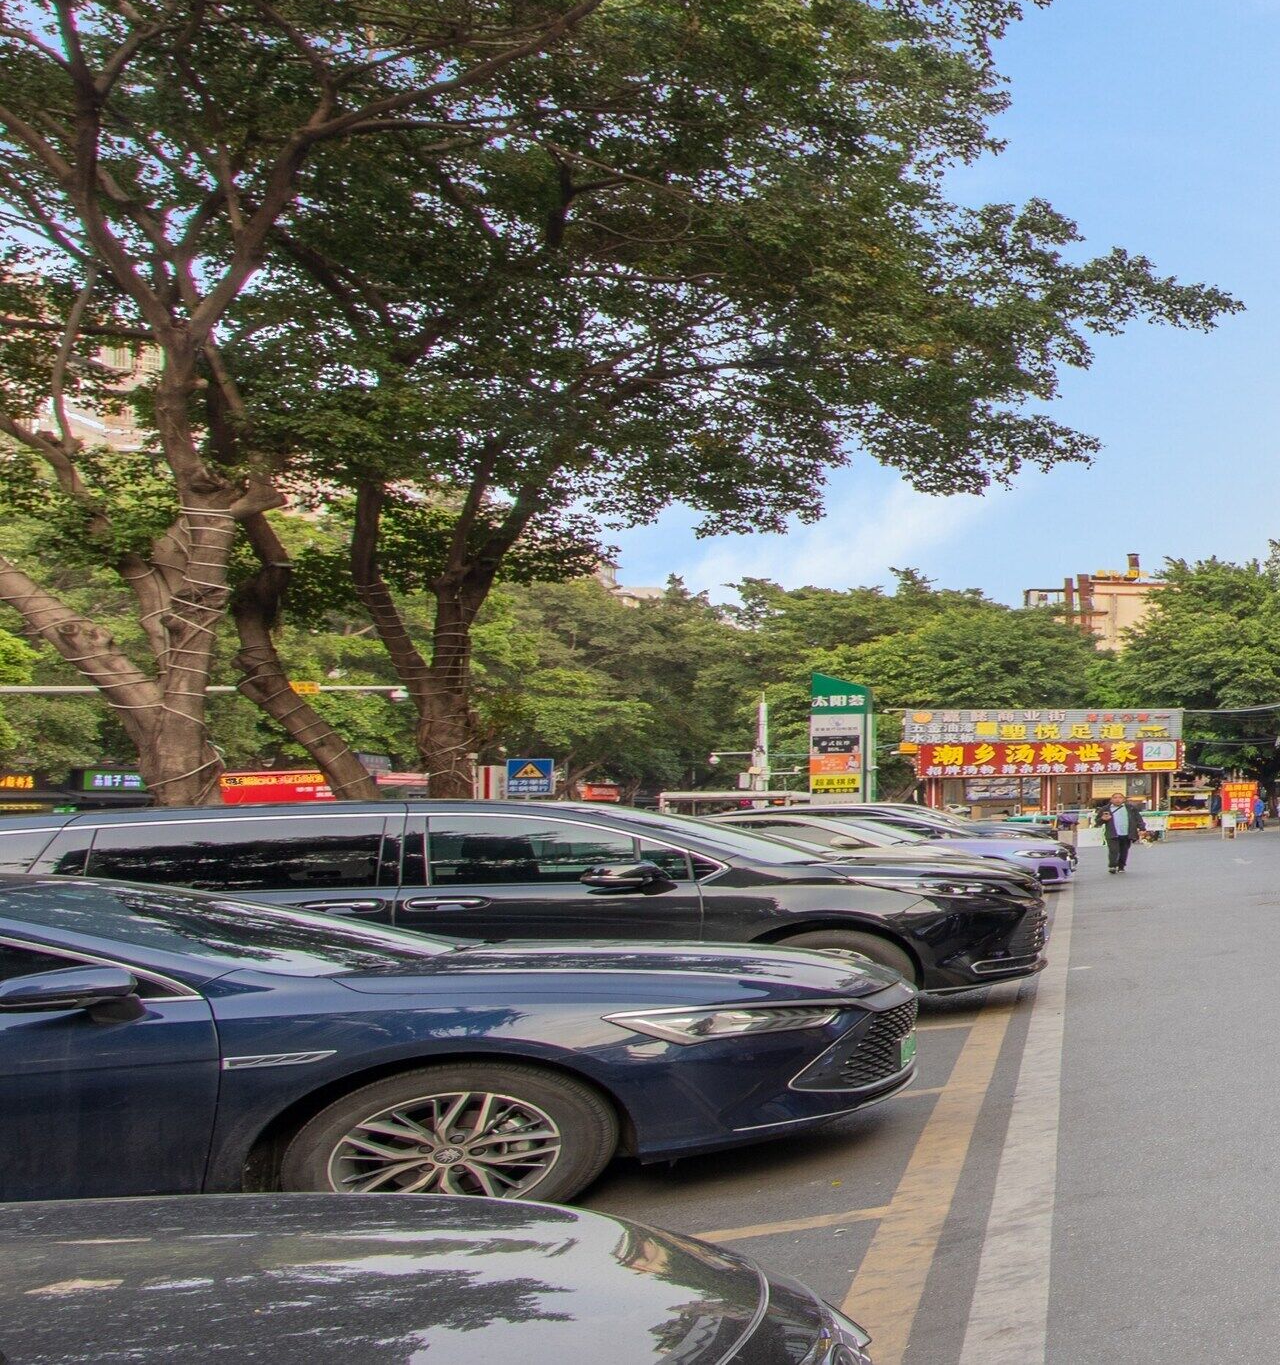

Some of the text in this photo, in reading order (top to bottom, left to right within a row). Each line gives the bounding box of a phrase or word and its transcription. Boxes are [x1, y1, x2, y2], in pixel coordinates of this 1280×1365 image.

[932, 740, 1138, 765] 潮乡汤粉世家
